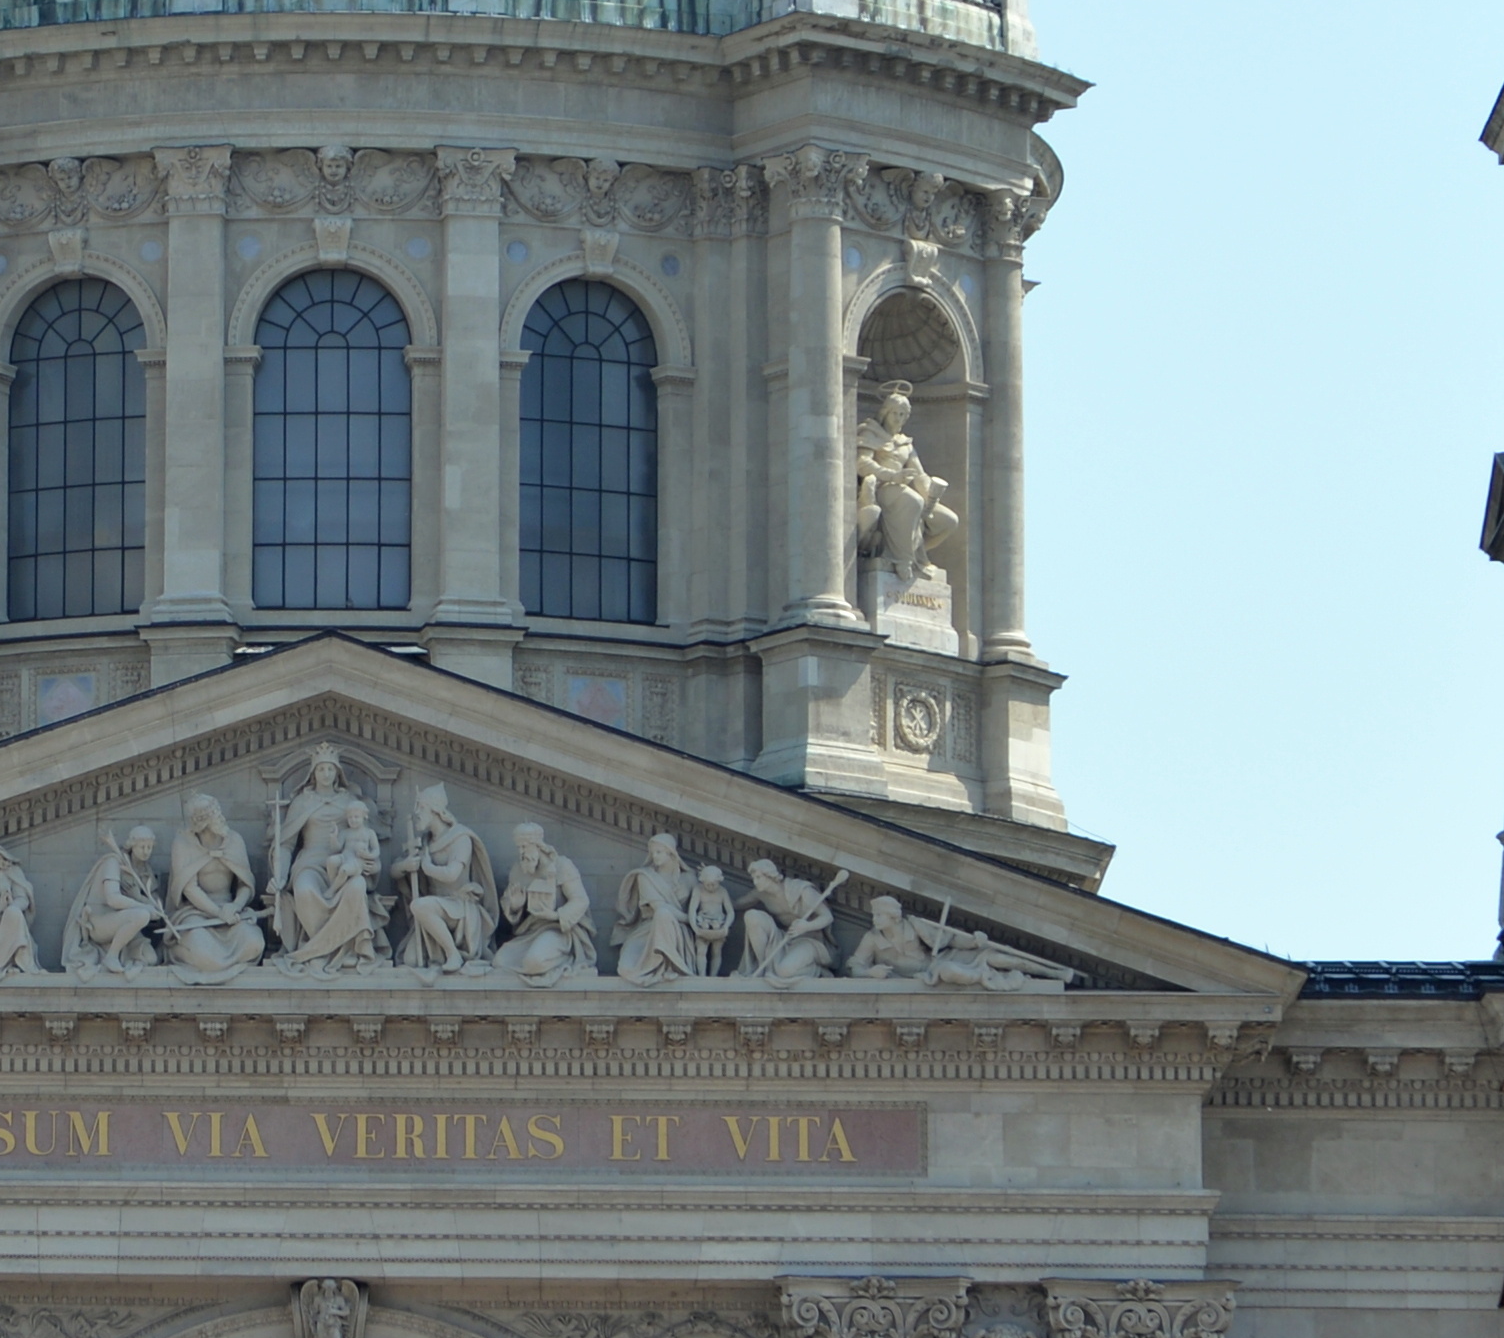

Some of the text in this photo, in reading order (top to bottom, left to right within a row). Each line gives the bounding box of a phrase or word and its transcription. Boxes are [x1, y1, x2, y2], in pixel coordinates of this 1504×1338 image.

[162, 1111, 268, 1158] VIA
[309, 1112, 567, 1161] VERITAS
[609, 1114, 680, 1161] ET
[723, 1115, 858, 1163] VITA
